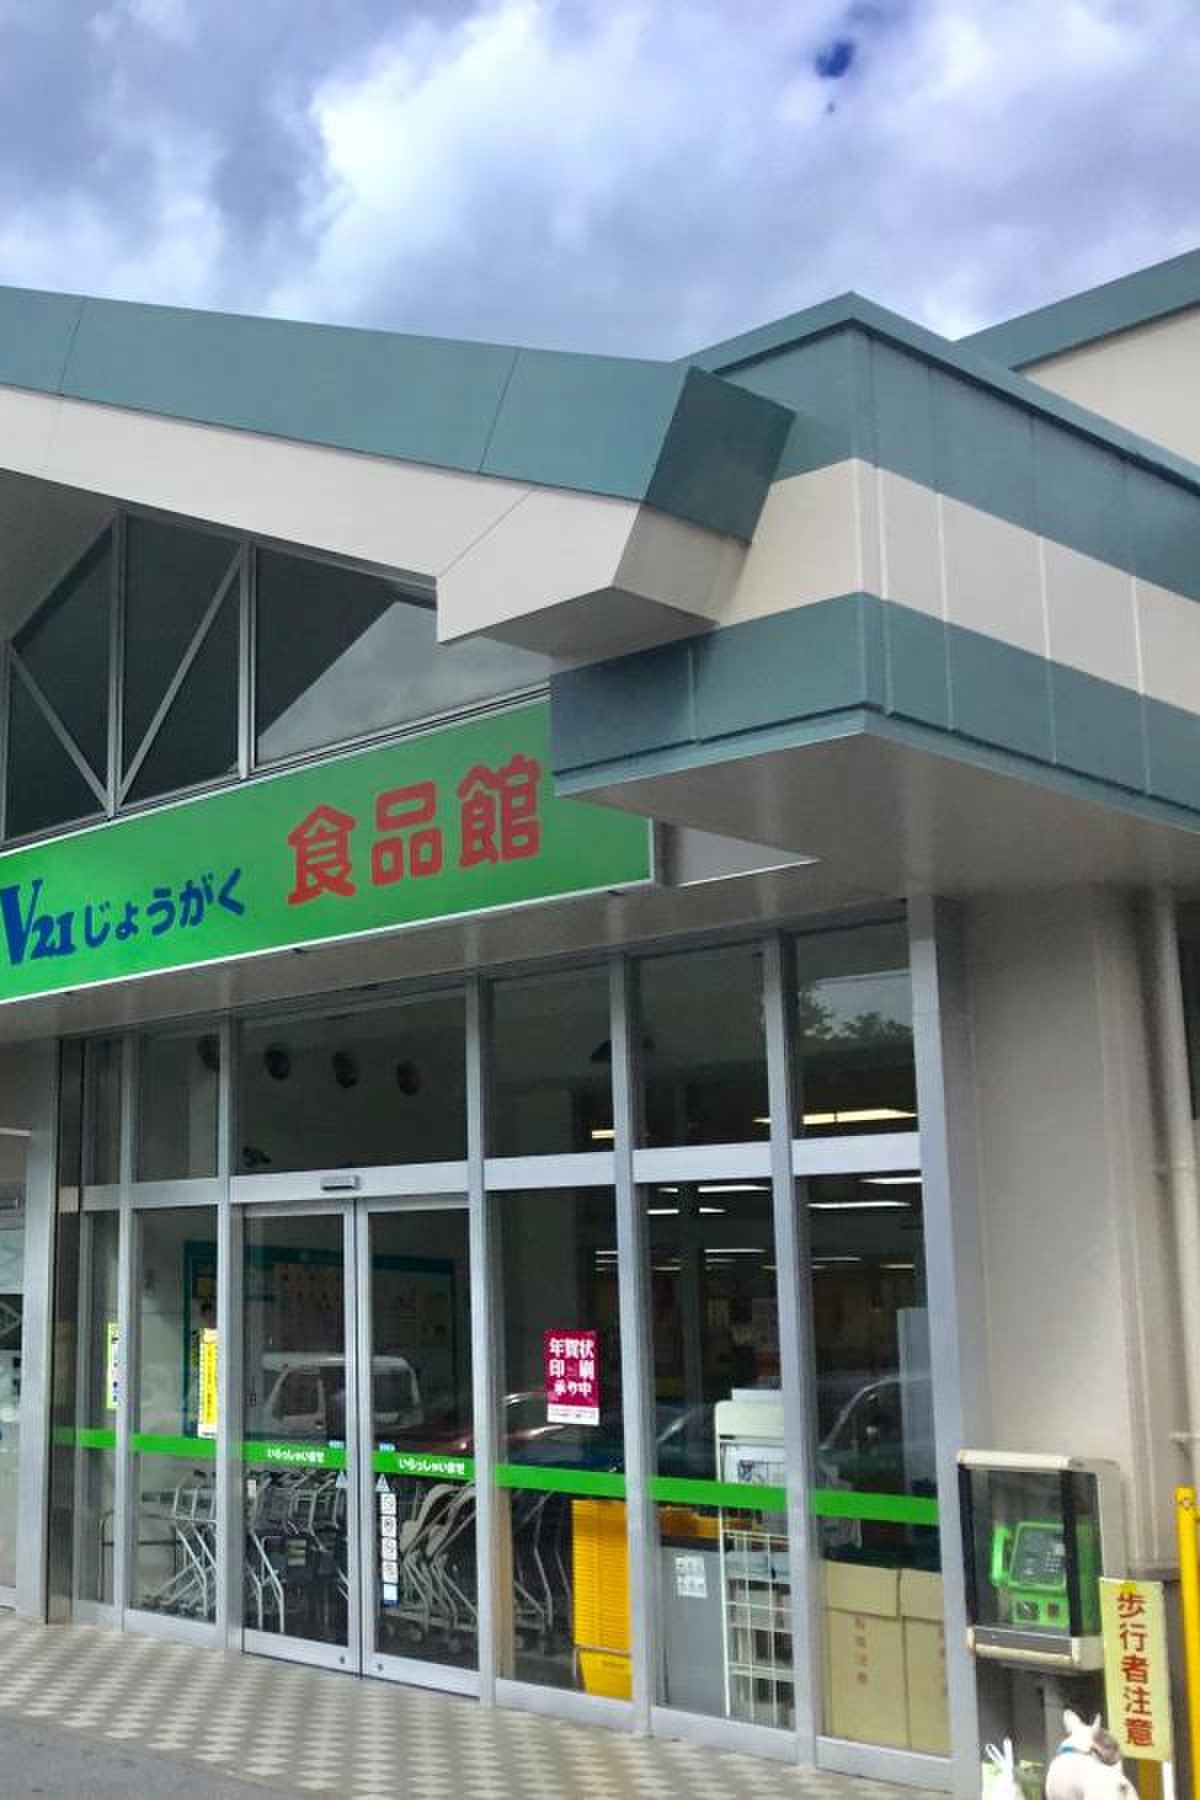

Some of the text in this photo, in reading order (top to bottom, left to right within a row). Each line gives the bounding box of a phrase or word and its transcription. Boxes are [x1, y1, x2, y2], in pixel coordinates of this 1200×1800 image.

[287, 753, 542, 906] 食品館
[549, 1338, 594, 1359] 年賀状
[1117, 1592, 1155, 1747] 歩行者注意
